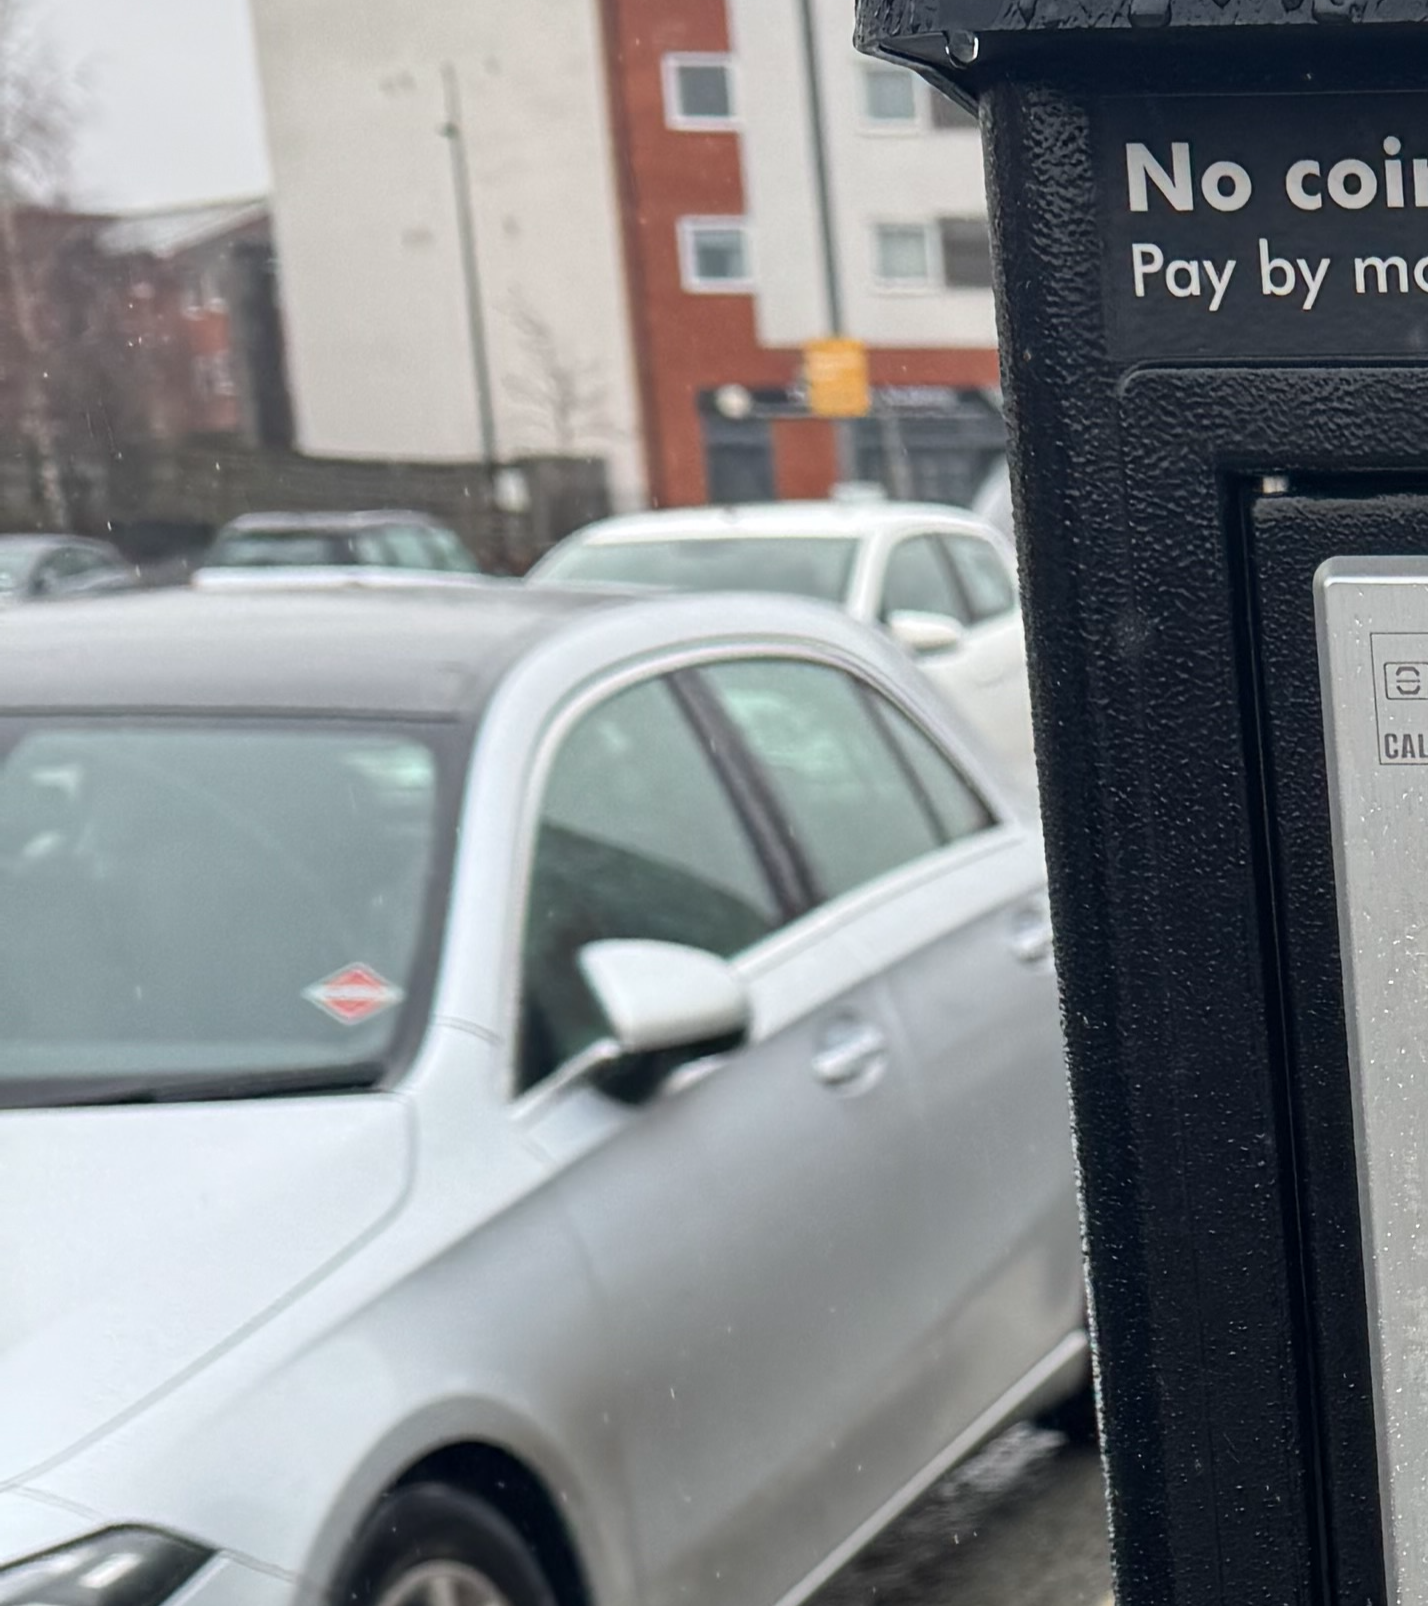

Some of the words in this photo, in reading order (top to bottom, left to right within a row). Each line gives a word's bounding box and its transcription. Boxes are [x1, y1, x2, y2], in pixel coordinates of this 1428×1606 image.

[1125, 142, 1252, 212] No
[1131, 242, 1236, 311] Pay
[1258, 239, 1330, 309] by
